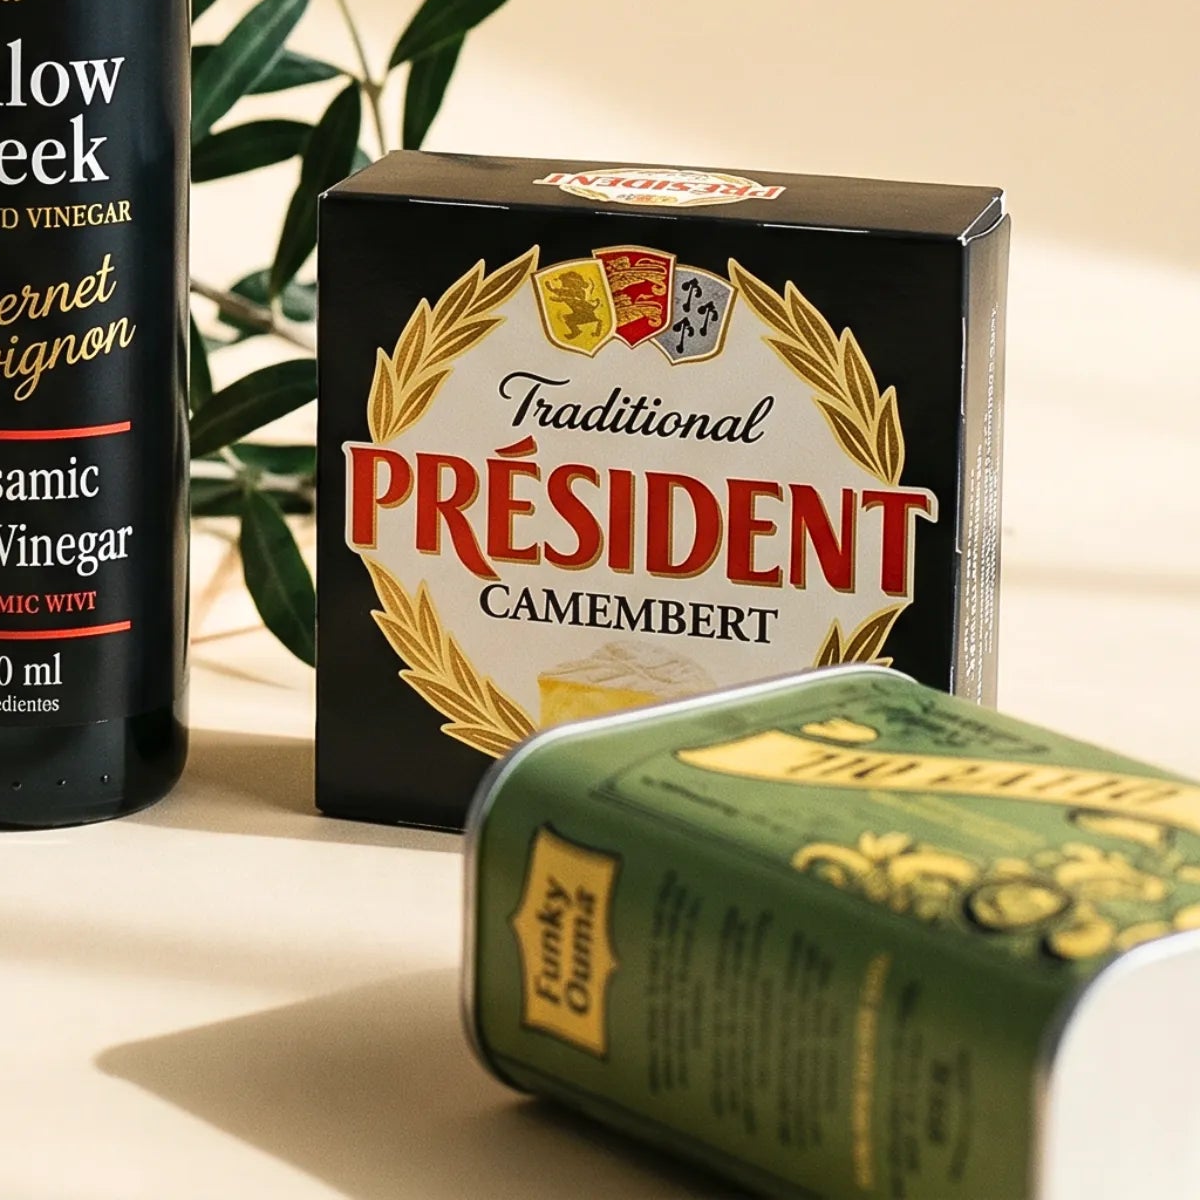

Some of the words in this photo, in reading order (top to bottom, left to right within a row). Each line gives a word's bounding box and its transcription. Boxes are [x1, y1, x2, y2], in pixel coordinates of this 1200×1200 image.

[26, 200, 132, 228] VINEGAR
[499, 371, 774, 444] Traditional
[350, 435, 932, 598] PRÉSIDENT
[479, 584, 779, 644] CAMEMBERT
[23, 652, 63, 686] ml
[535, 874, 573, 1006] Funky
